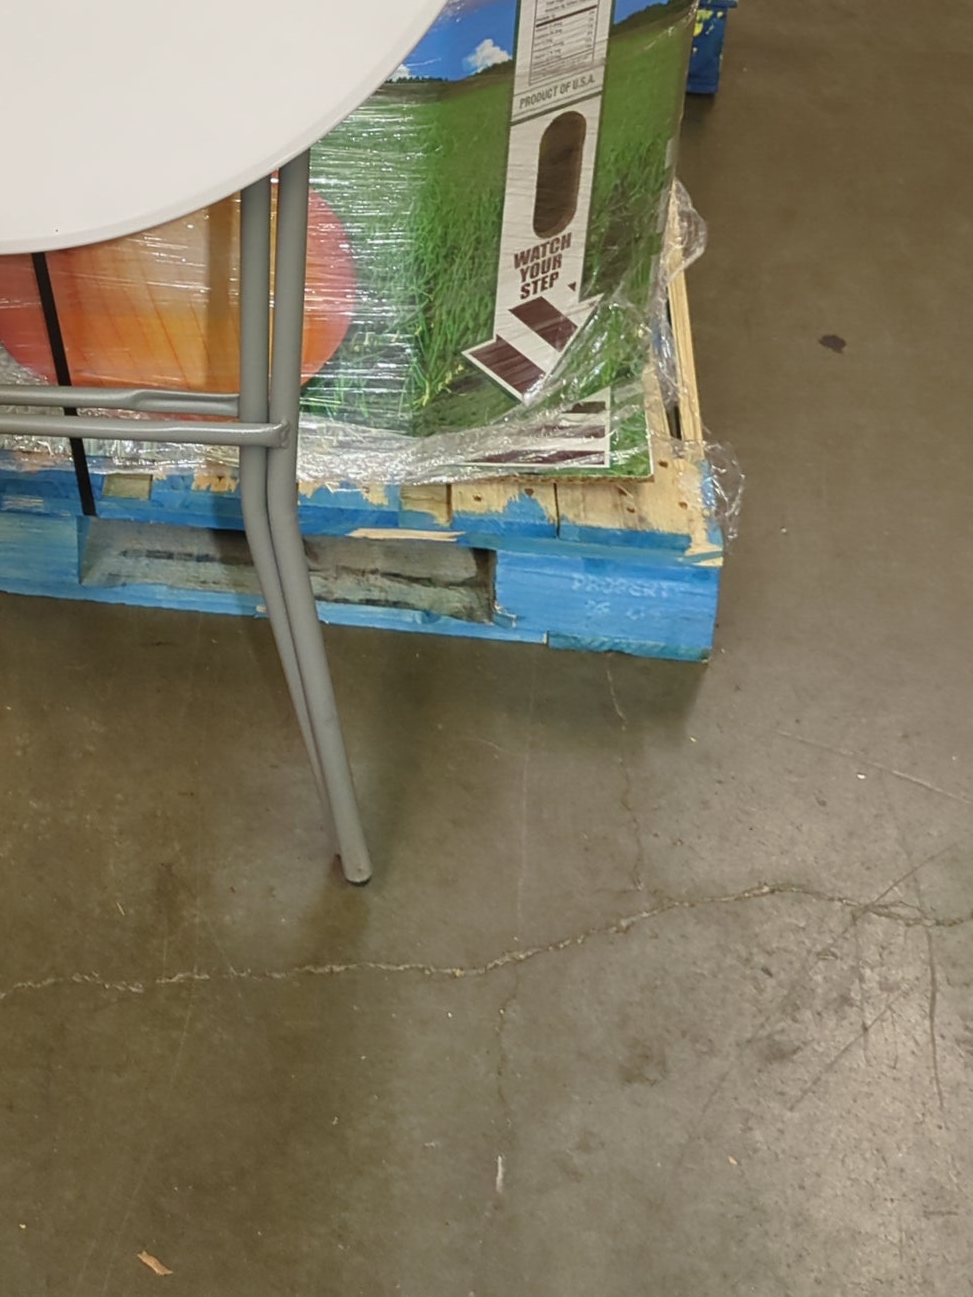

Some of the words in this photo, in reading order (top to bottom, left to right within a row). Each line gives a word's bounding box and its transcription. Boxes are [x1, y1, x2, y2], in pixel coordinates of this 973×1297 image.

[519, 86, 558, 109] PRODUCT
[559, 81, 571, 94] OF
[572, 74, 595, 90] U.S.A.
[514, 232, 572, 269] WATCH
[519, 253, 563, 283] YOUR
[520, 271, 559, 300] STEP
